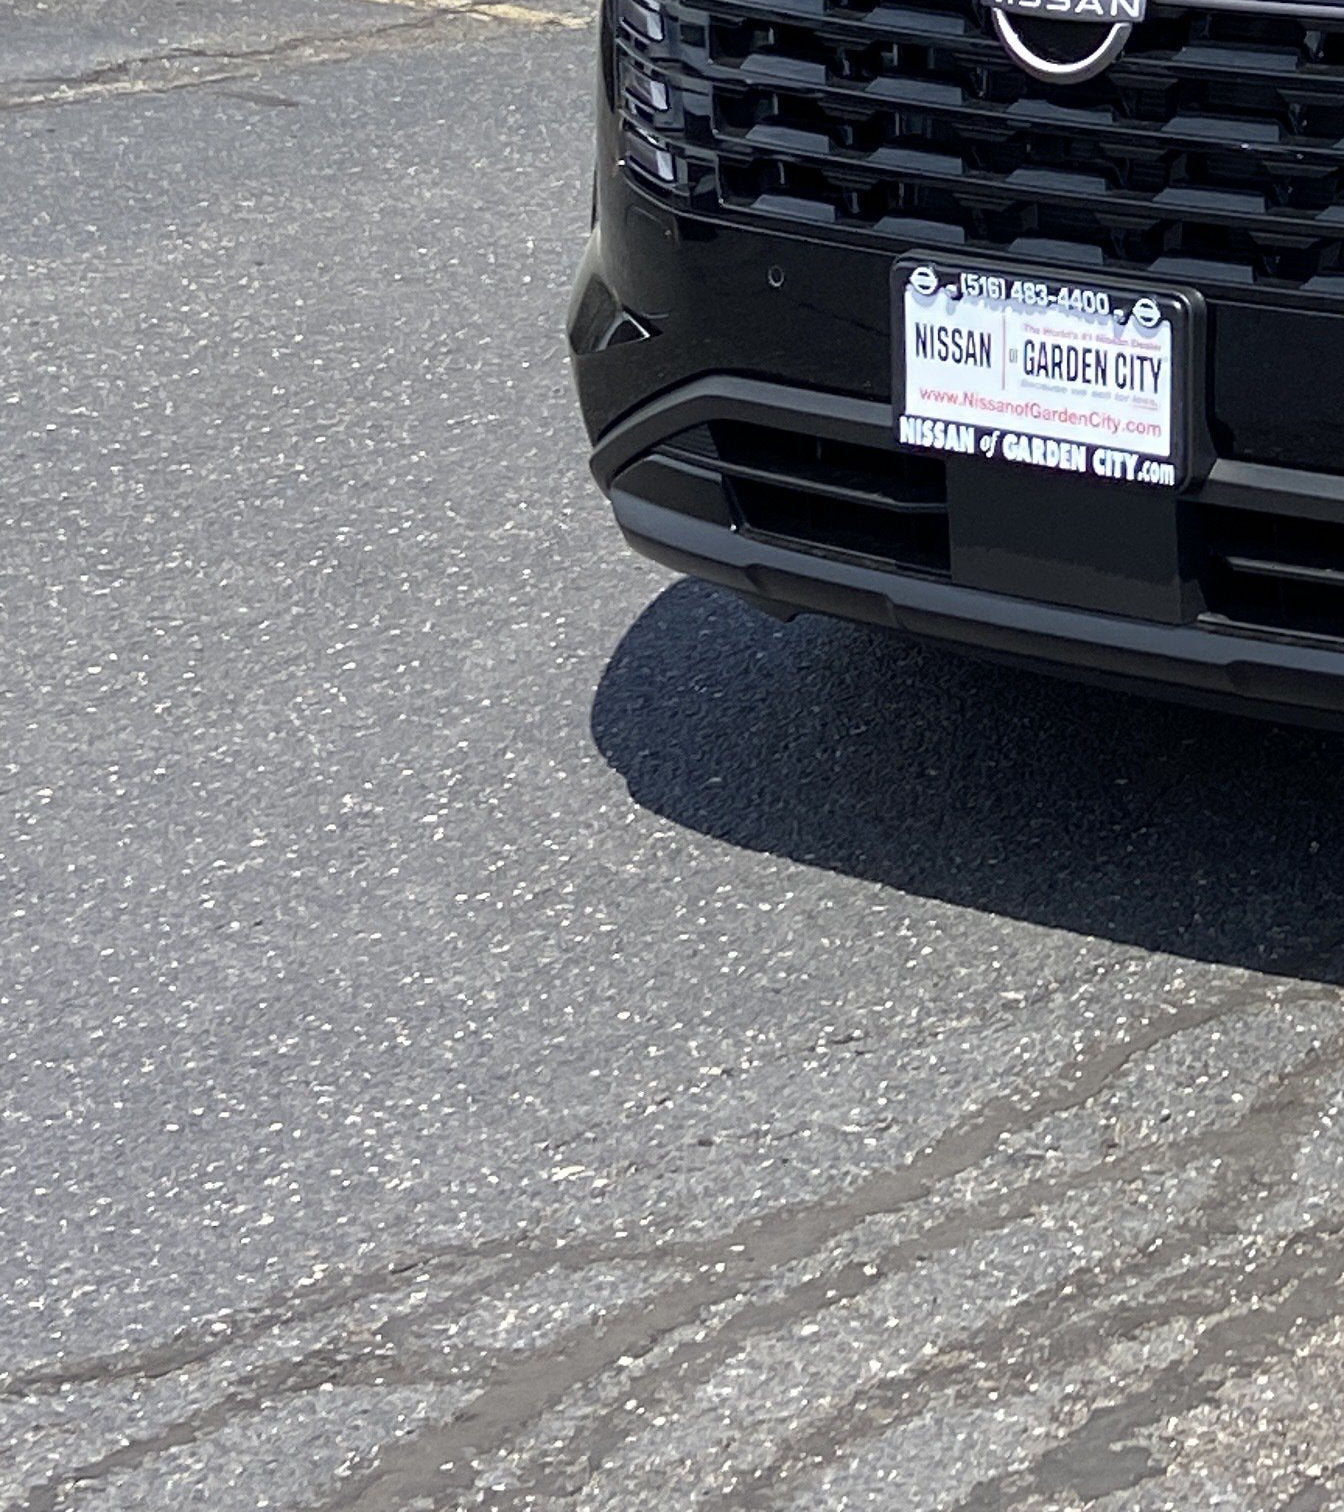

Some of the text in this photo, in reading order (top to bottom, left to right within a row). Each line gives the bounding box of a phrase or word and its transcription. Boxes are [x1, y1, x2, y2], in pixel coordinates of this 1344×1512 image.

[960, 272, 1110, 315] (516) 483-4400
[915, 322, 992, 368] NISSAN
[1024, 339, 1108, 387] GARDEN
[1115, 352, 1162, 394] CITY
[919, 387, 1162, 437] www.NissanofGardenCity.com
[900, 416, 1176, 486] NISSAN of GARDEN CITY.com
